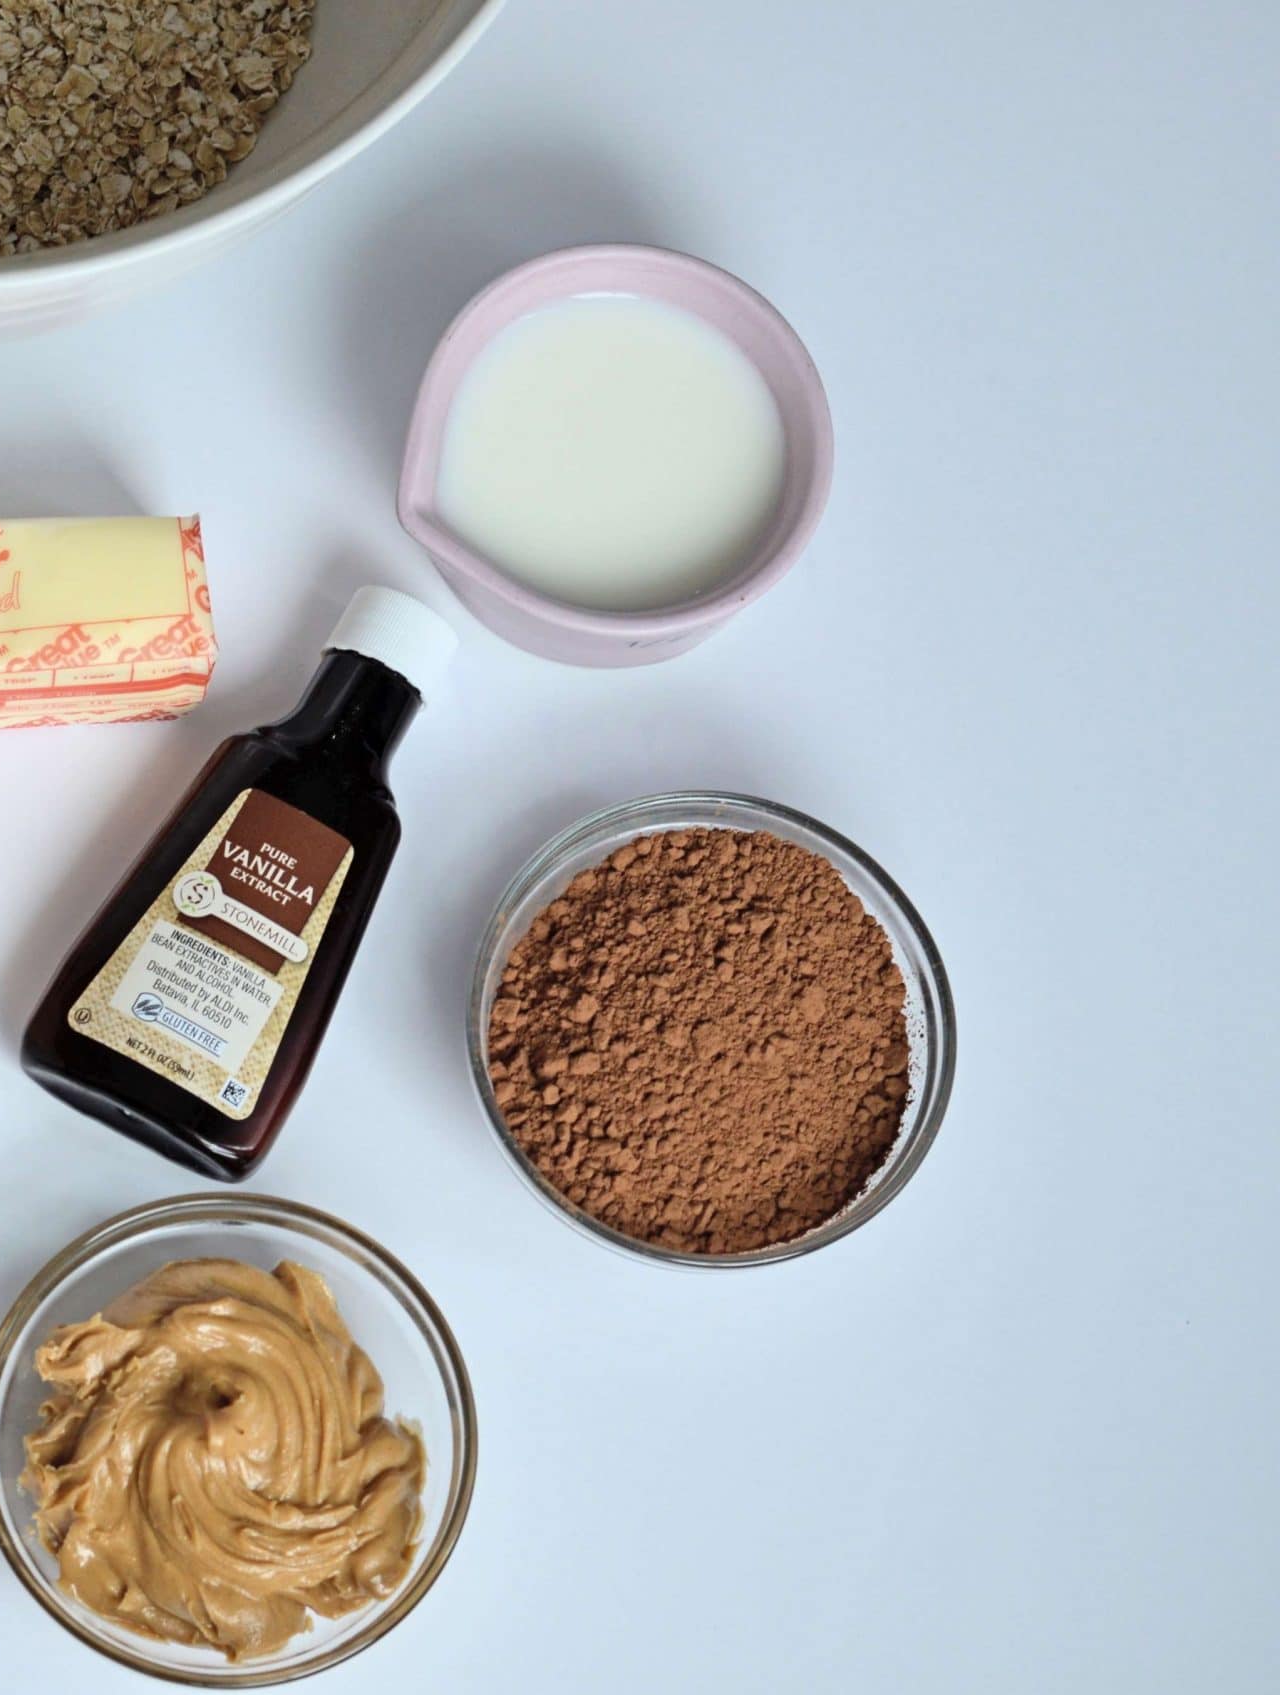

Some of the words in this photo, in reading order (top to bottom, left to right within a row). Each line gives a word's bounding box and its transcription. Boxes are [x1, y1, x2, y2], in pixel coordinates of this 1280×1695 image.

[224, 840, 314, 905] VANILLA
[260, 842, 297, 869] PURE
[230, 867, 292, 905] EXTRACT
[221, 902, 297, 955] STONEMILL
[151, 933, 175, 952] BEAN
[175, 943, 230, 981] EXTRACTIVES
[230, 976, 241, 987] IN
[171, 929, 231, 968] INGREDIENTS:
[232, 962, 266, 988] VANILLA
[176, 960, 196, 975] AND
[146, 959, 198, 993] Distributed
[199, 987, 211, 1001] by
[211, 995, 234, 1014] ALDI
[234, 1009, 249, 1025] Inc.
[152, 979, 189, 1008] Batavia,
[191, 999, 200, 1012] IL
[202, 1006, 232, 1030] 60510
[126, 1037, 142, 1049] NET
[162, 1013, 198, 1038] GLUTEN
[198, 1031, 221, 1051] FREE
